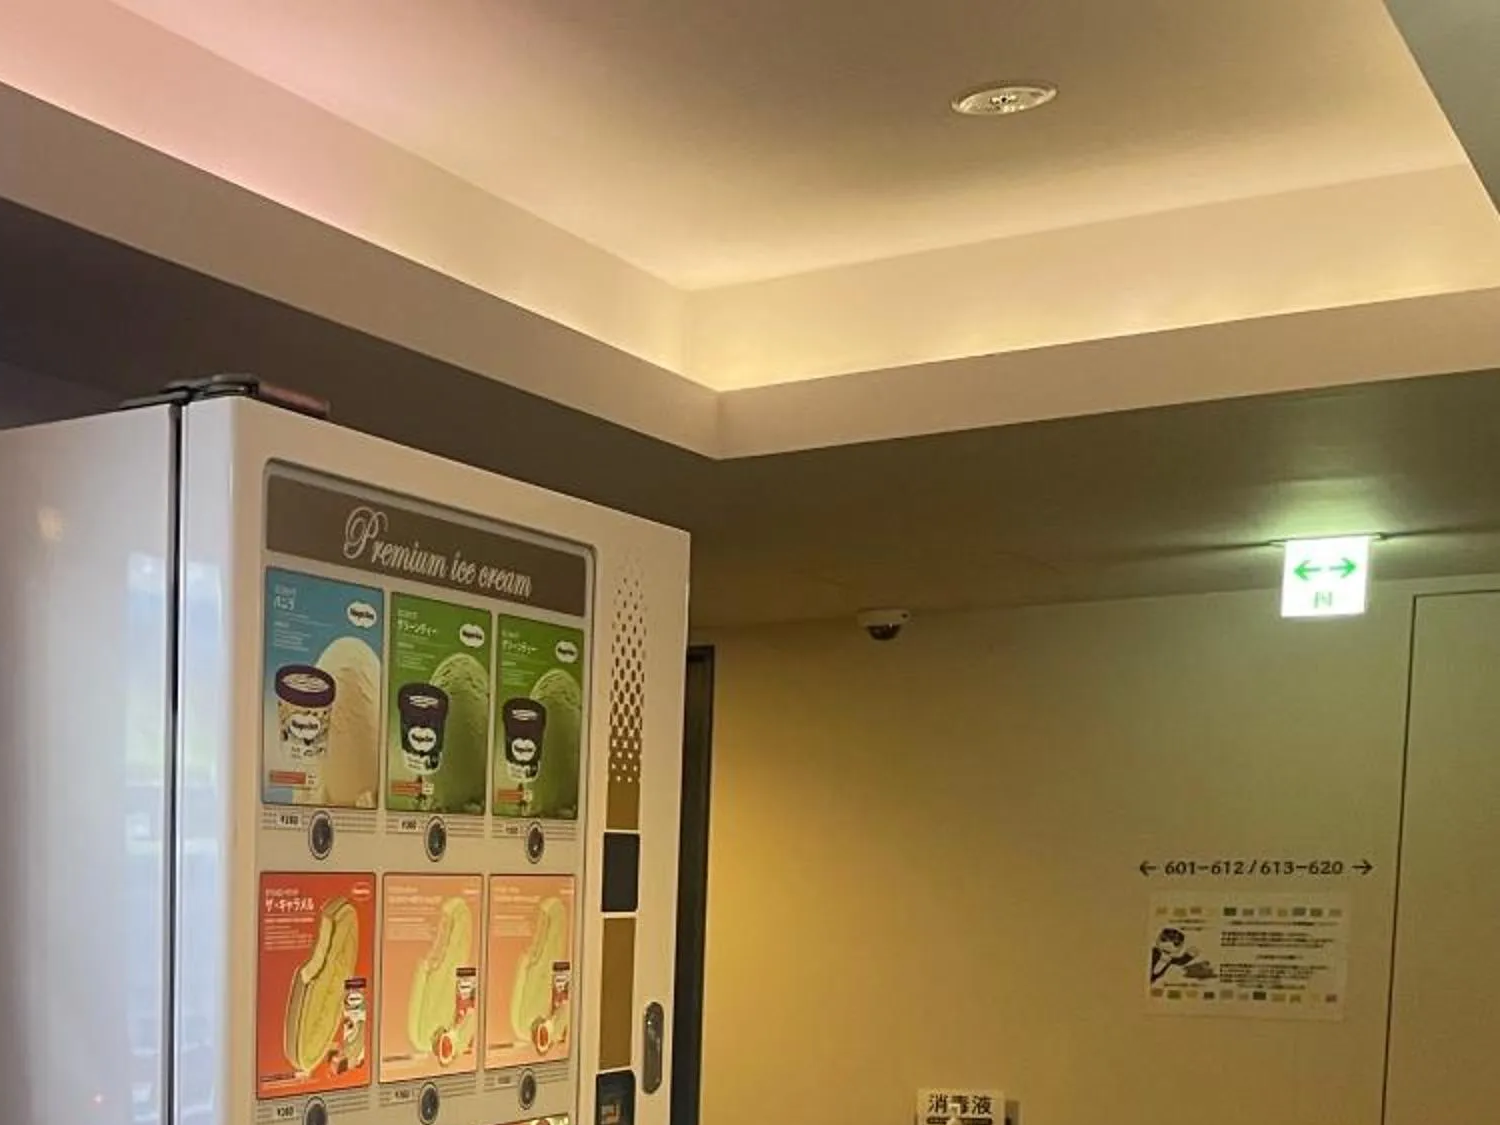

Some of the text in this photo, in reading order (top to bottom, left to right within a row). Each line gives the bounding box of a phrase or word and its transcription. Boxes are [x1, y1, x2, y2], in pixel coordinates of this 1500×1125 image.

[343, 506, 532, 598] Premium ice cream
[928, 1095, 993, 1116] 消毒液
